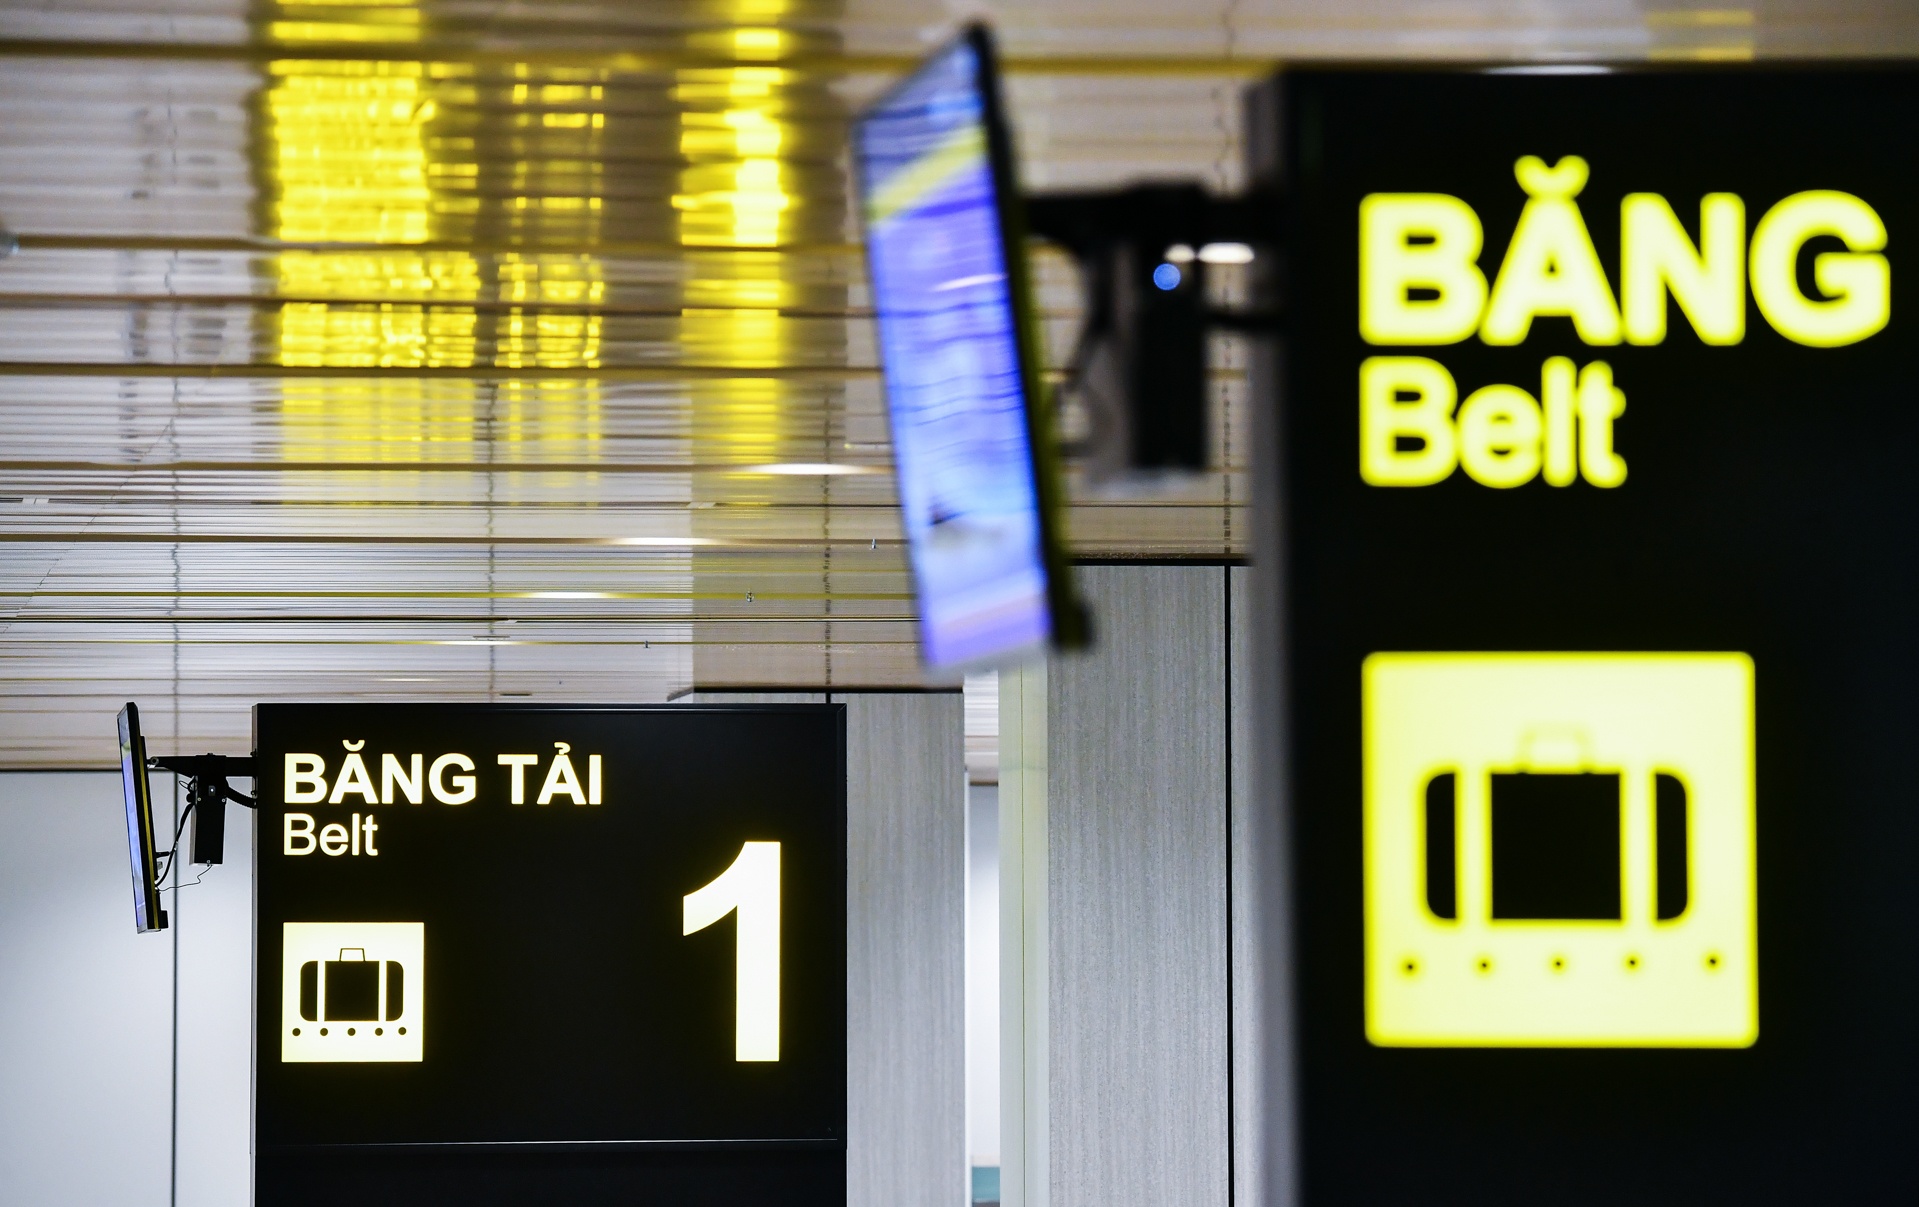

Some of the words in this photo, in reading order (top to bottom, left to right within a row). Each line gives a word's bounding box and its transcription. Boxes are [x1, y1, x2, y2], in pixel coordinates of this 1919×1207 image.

[1359, 155, 1891, 348] BĂNG
[1359, 355, 1628, 489] Belt
[283, 740, 477, 805] BĂNG
[498, 741, 602, 805] TẢI
[283, 813, 379, 856] Belt
[683, 841, 781, 1062] 1
